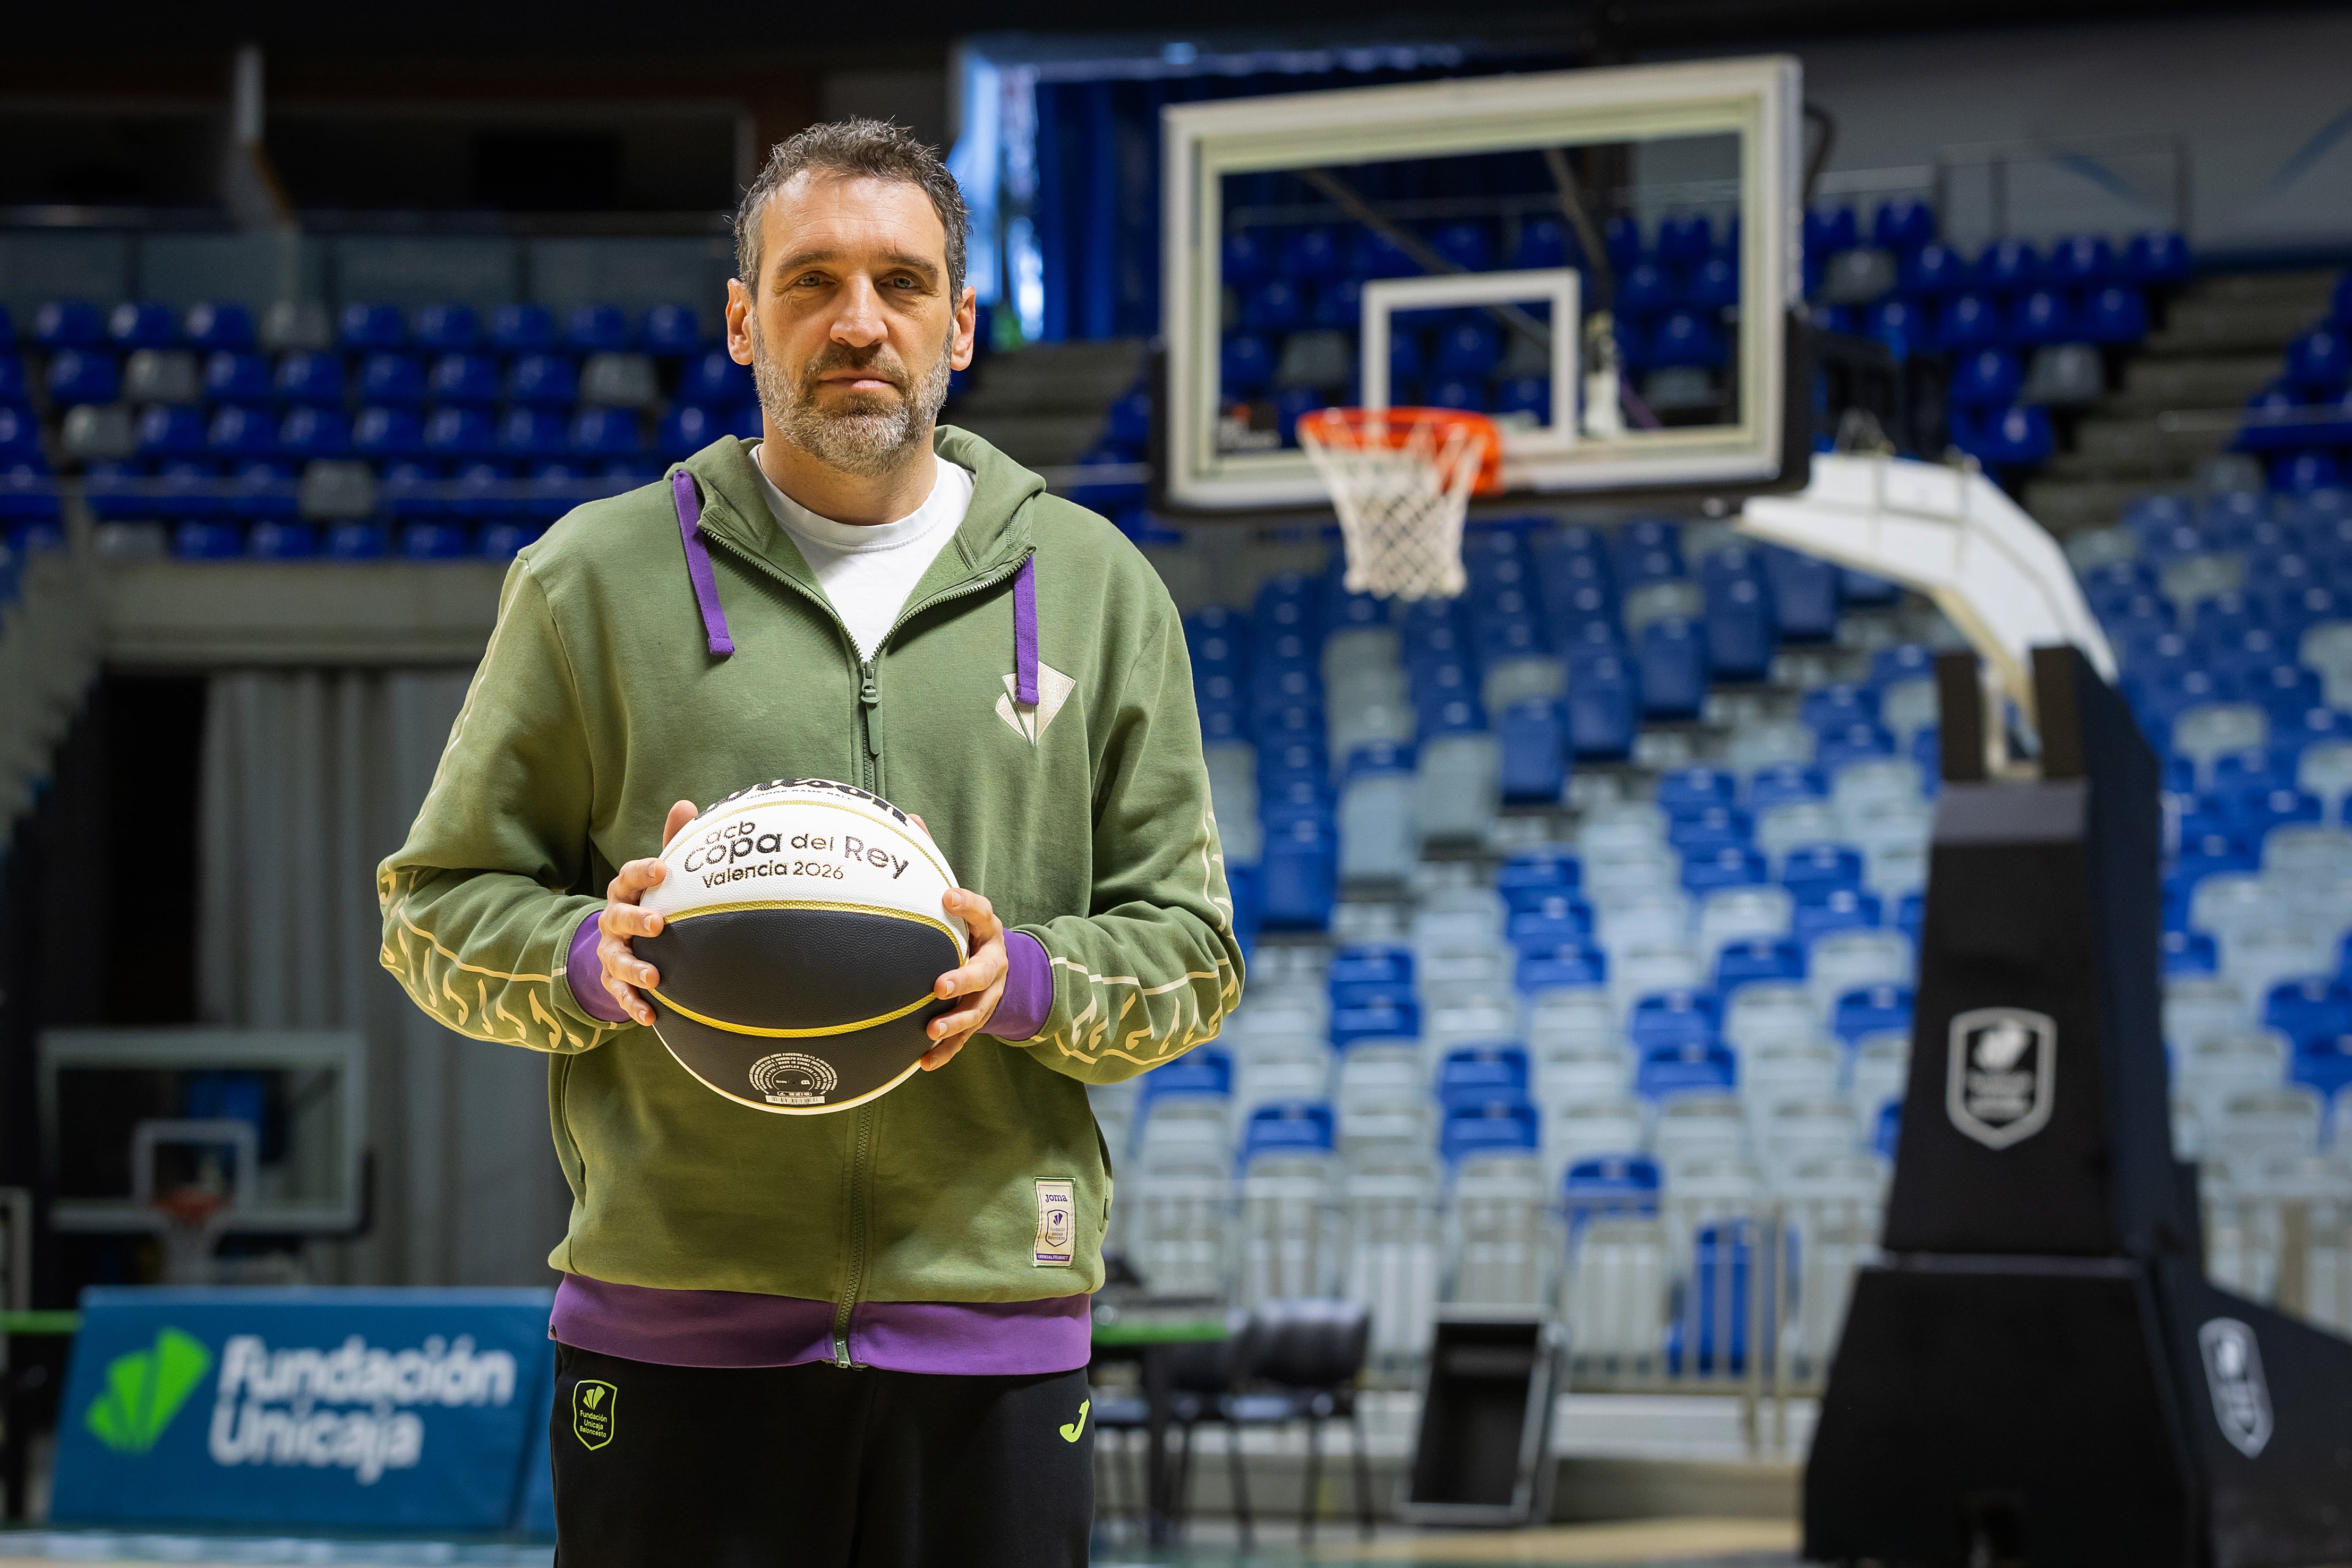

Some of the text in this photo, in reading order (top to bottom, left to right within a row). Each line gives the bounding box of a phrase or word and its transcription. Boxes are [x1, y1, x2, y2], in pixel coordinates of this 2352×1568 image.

[705, 821, 756, 844] acb
[685, 833, 909, 879] Copa del Rey
[702, 860, 844, 888] Valencia 2026
[221, 1335, 515, 1406] Fundación
[580, 1410, 608, 1423] Fundación
[584, 1419, 603, 1430] Unicaja
[210, 1400, 423, 1485] Unicaja
[579, 1425, 606, 1438] Baloncesto
